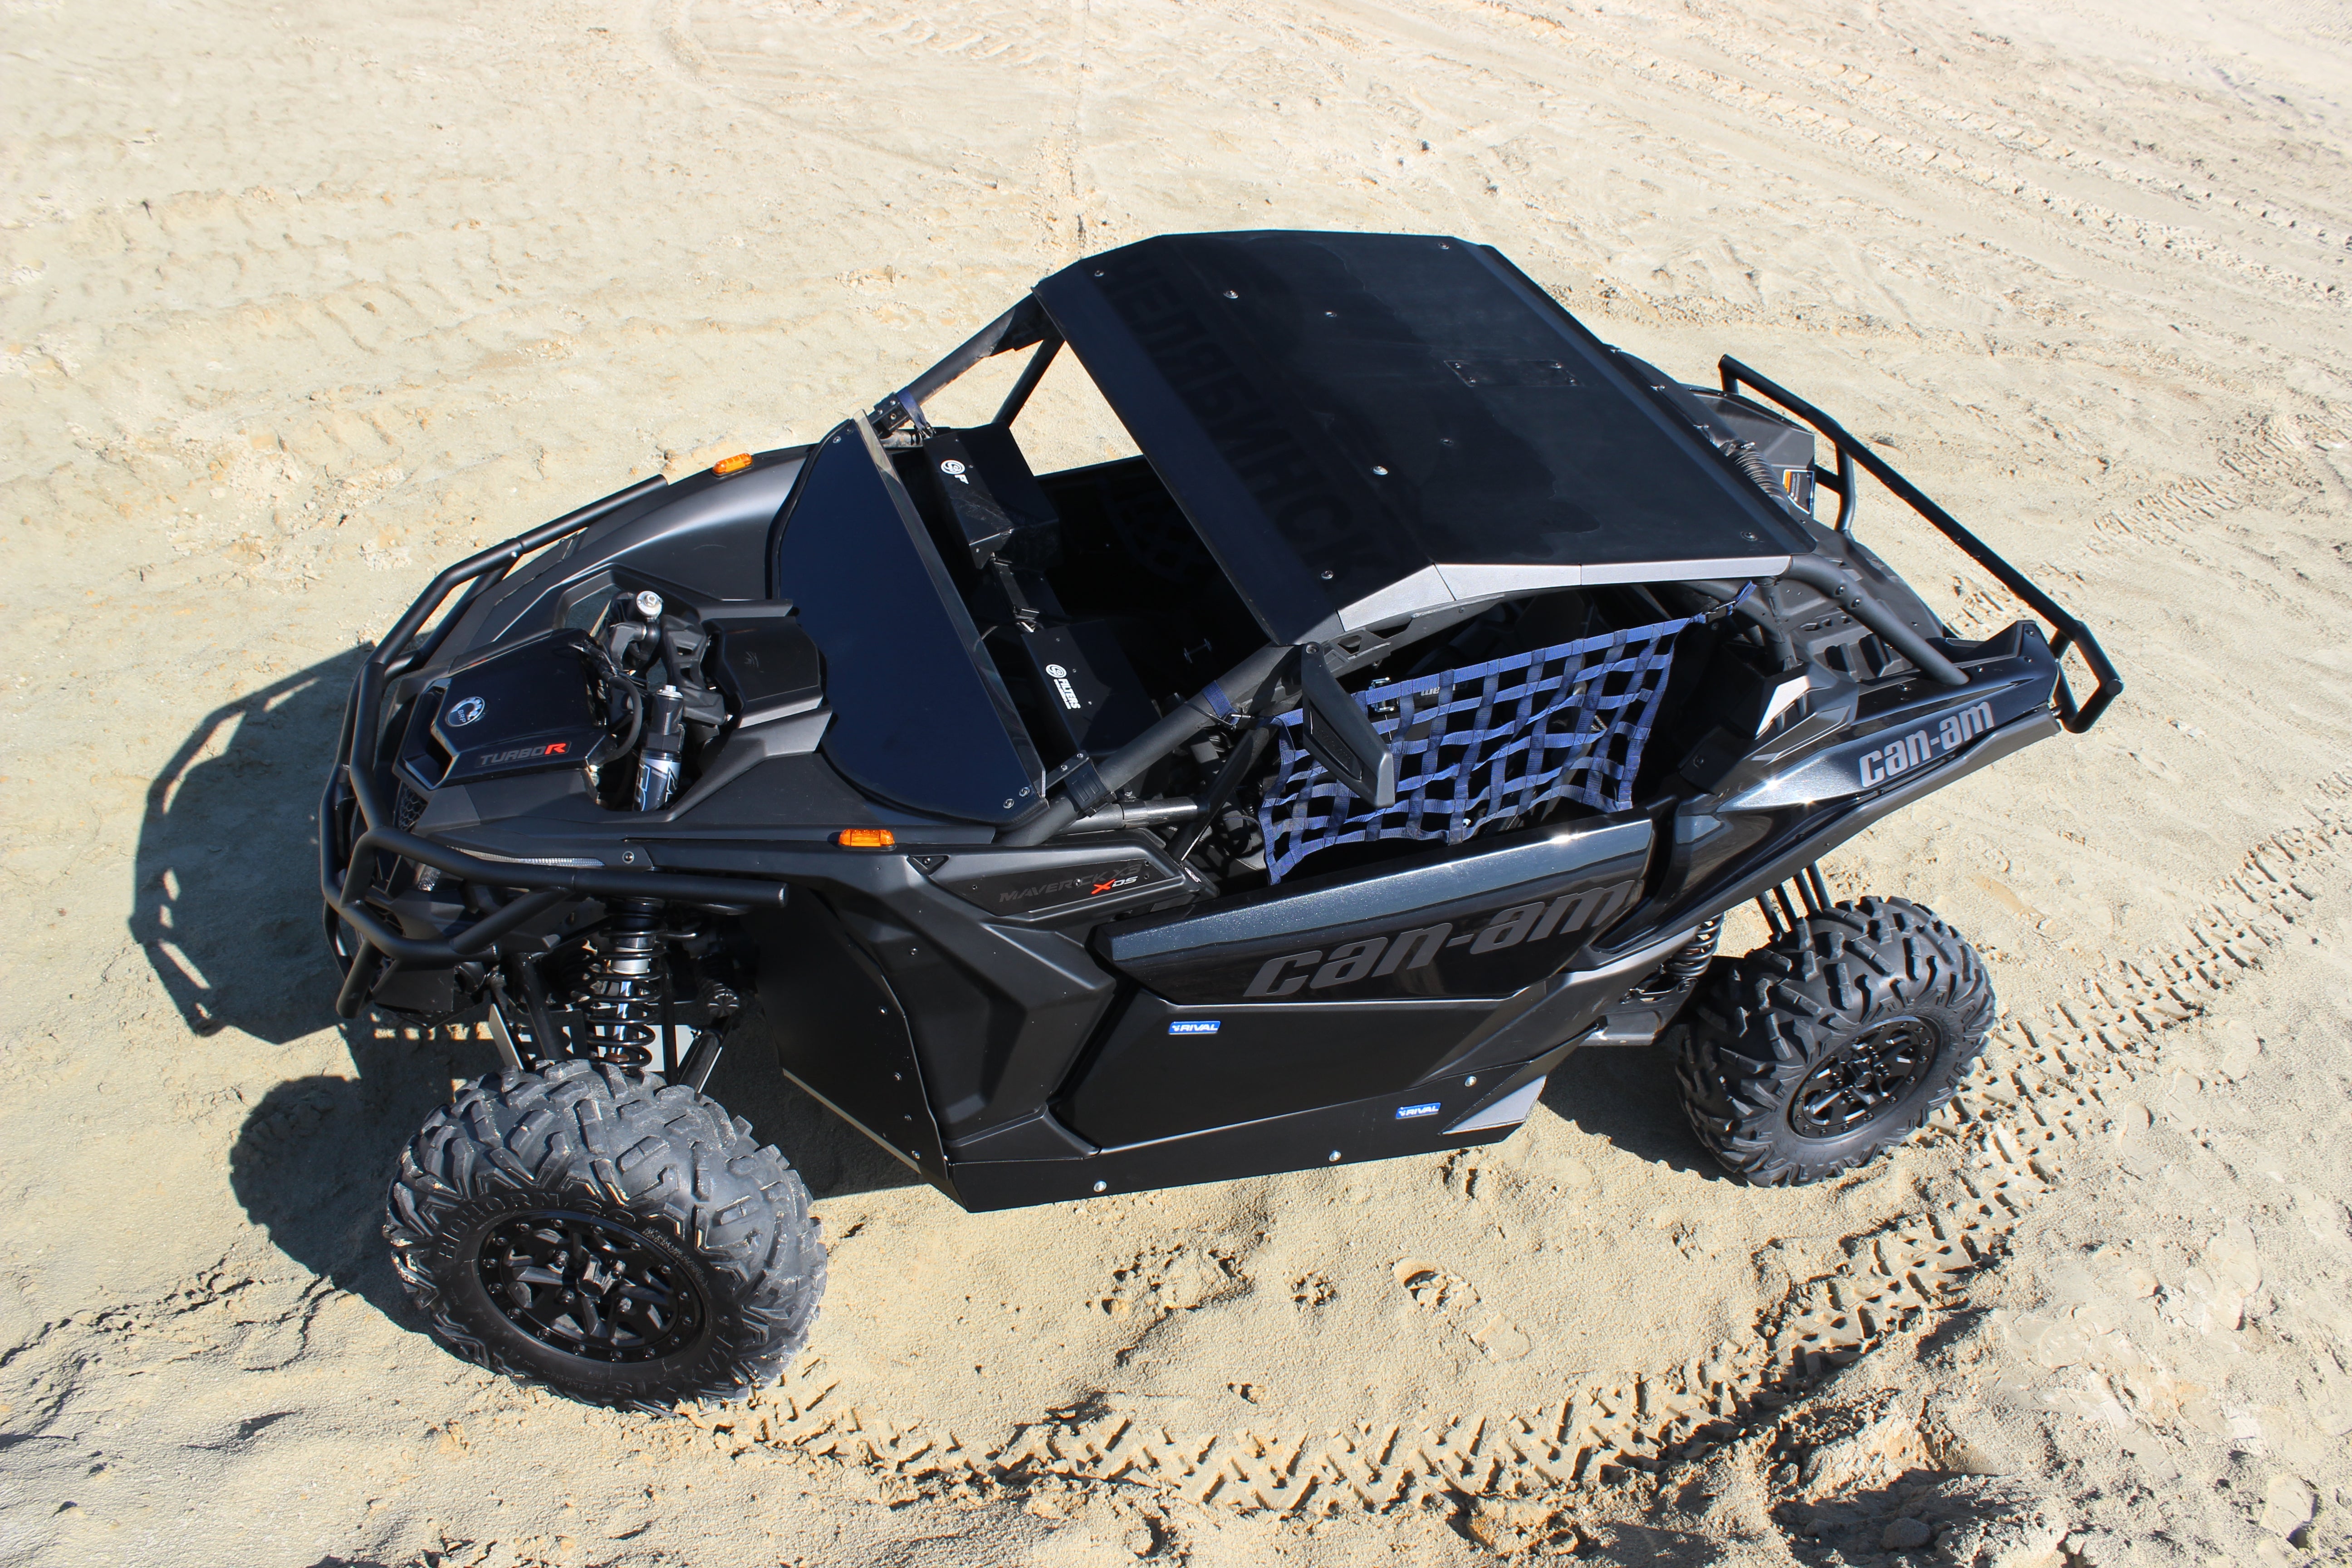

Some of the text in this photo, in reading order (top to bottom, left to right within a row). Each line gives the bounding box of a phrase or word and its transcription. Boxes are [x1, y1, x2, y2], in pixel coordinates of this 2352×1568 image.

[1058, 678, 1081, 709] FILTERS
[457, 709, 466, 723] BRP
[1859, 701, 1995, 788] can-am
[999, 863, 1142, 903] MAVERCK X3
[1243, 880, 1635, 997] can-am
[1406, 1105, 1439, 1116] RIVAL
[438, 1193, 560, 1261] BIGHORN
